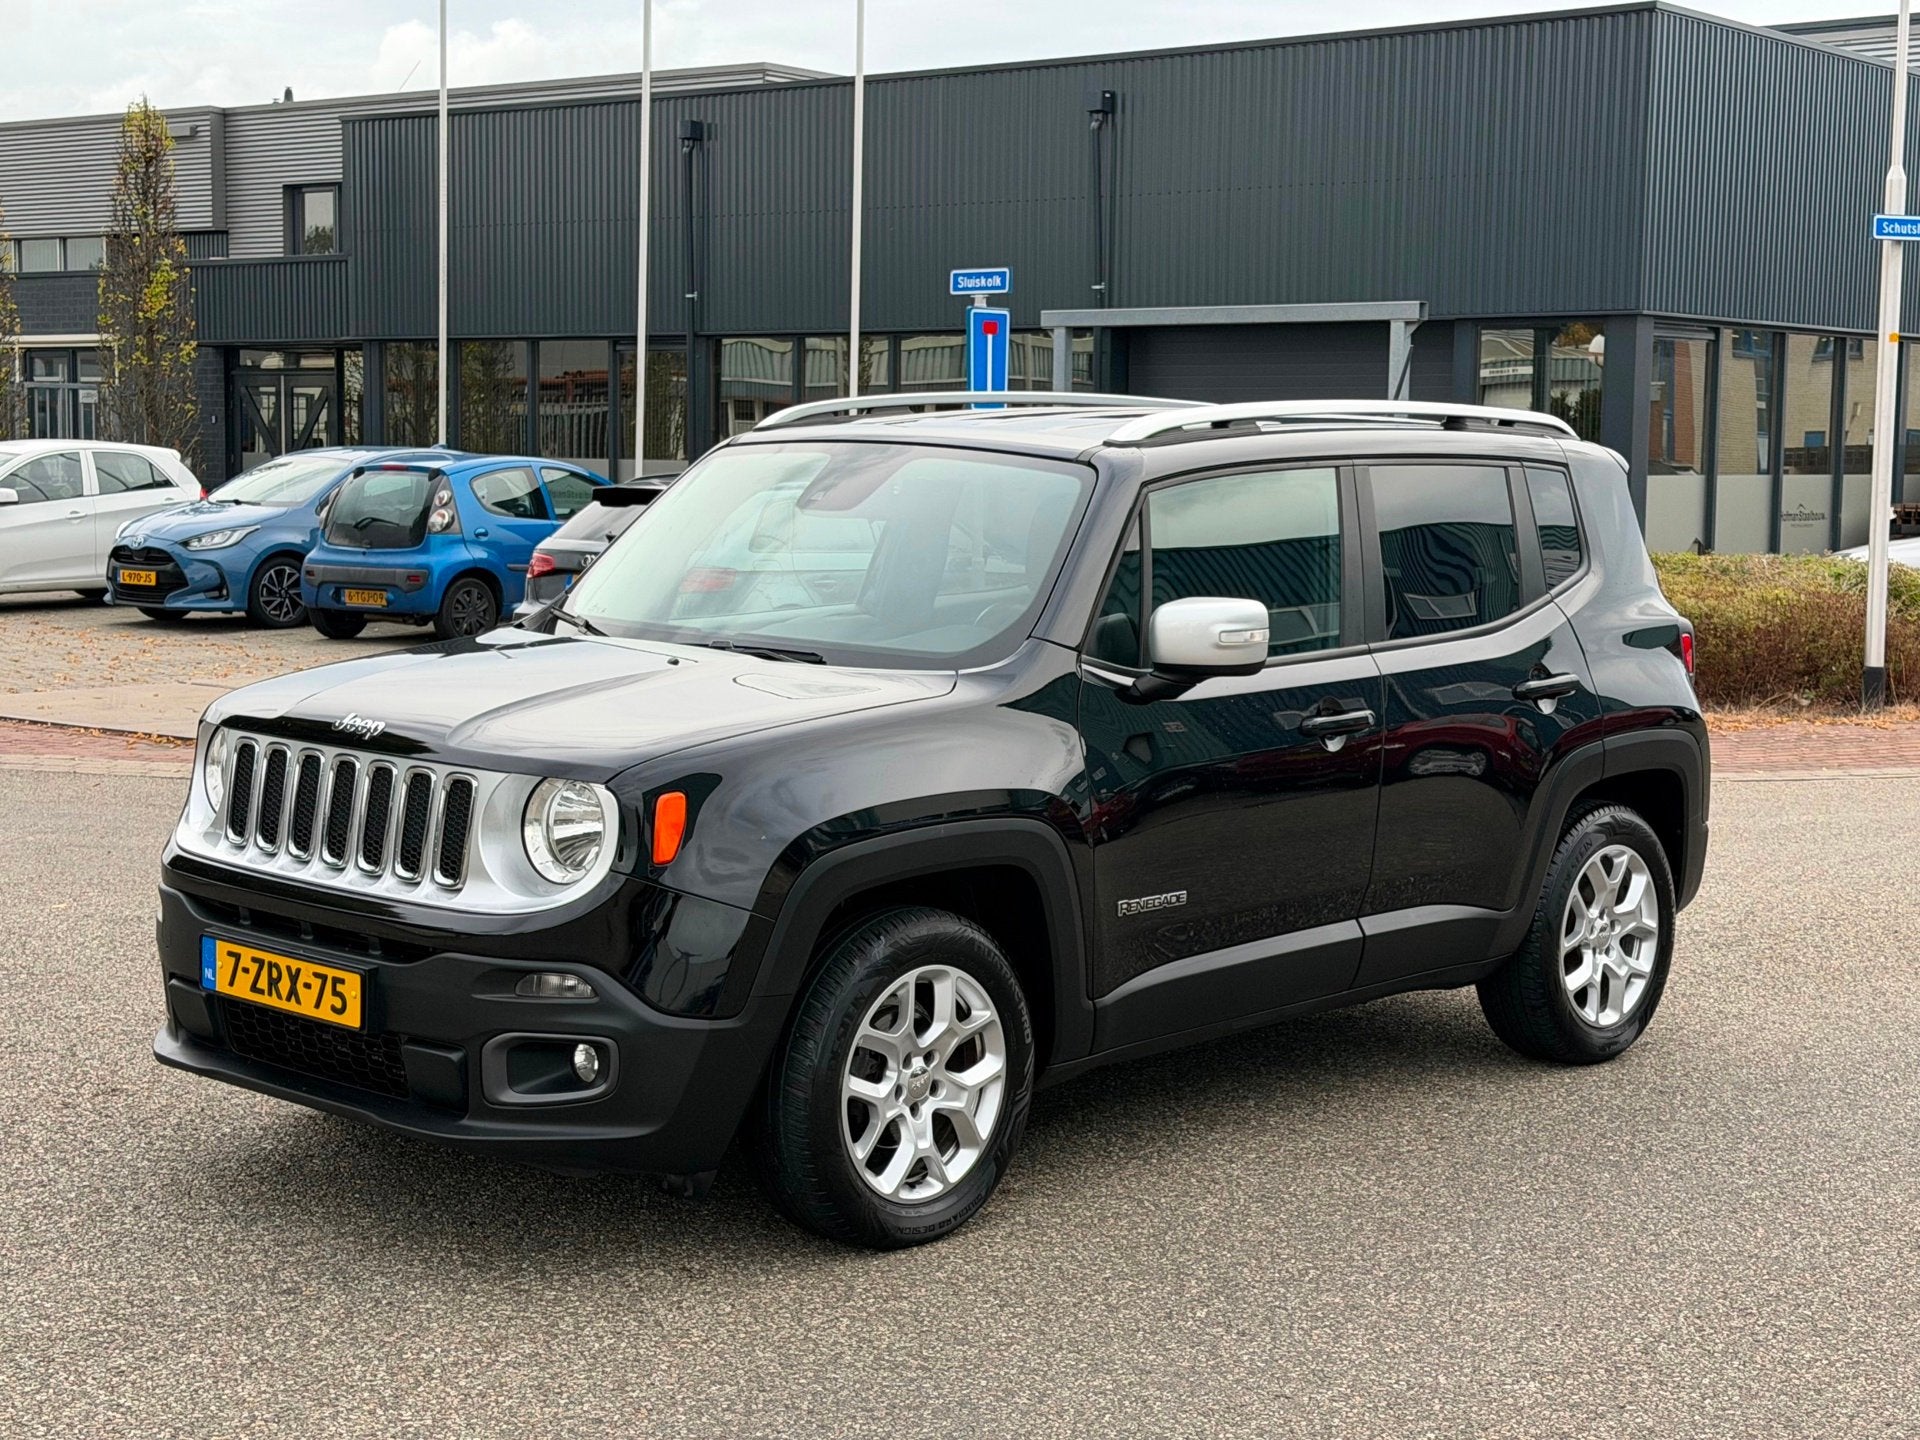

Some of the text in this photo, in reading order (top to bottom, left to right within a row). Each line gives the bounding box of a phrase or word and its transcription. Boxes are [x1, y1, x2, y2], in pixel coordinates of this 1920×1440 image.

[957, 275, 1001, 289] Sluiskolk
[121, 571, 153, 583] L-970-JS
[331, 712, 386, 740] Jeep
[1117, 890, 1187, 917] RENEGADE
[204, 967, 215, 981] NL
[226, 950, 348, 1016] 7-ZRX-75
